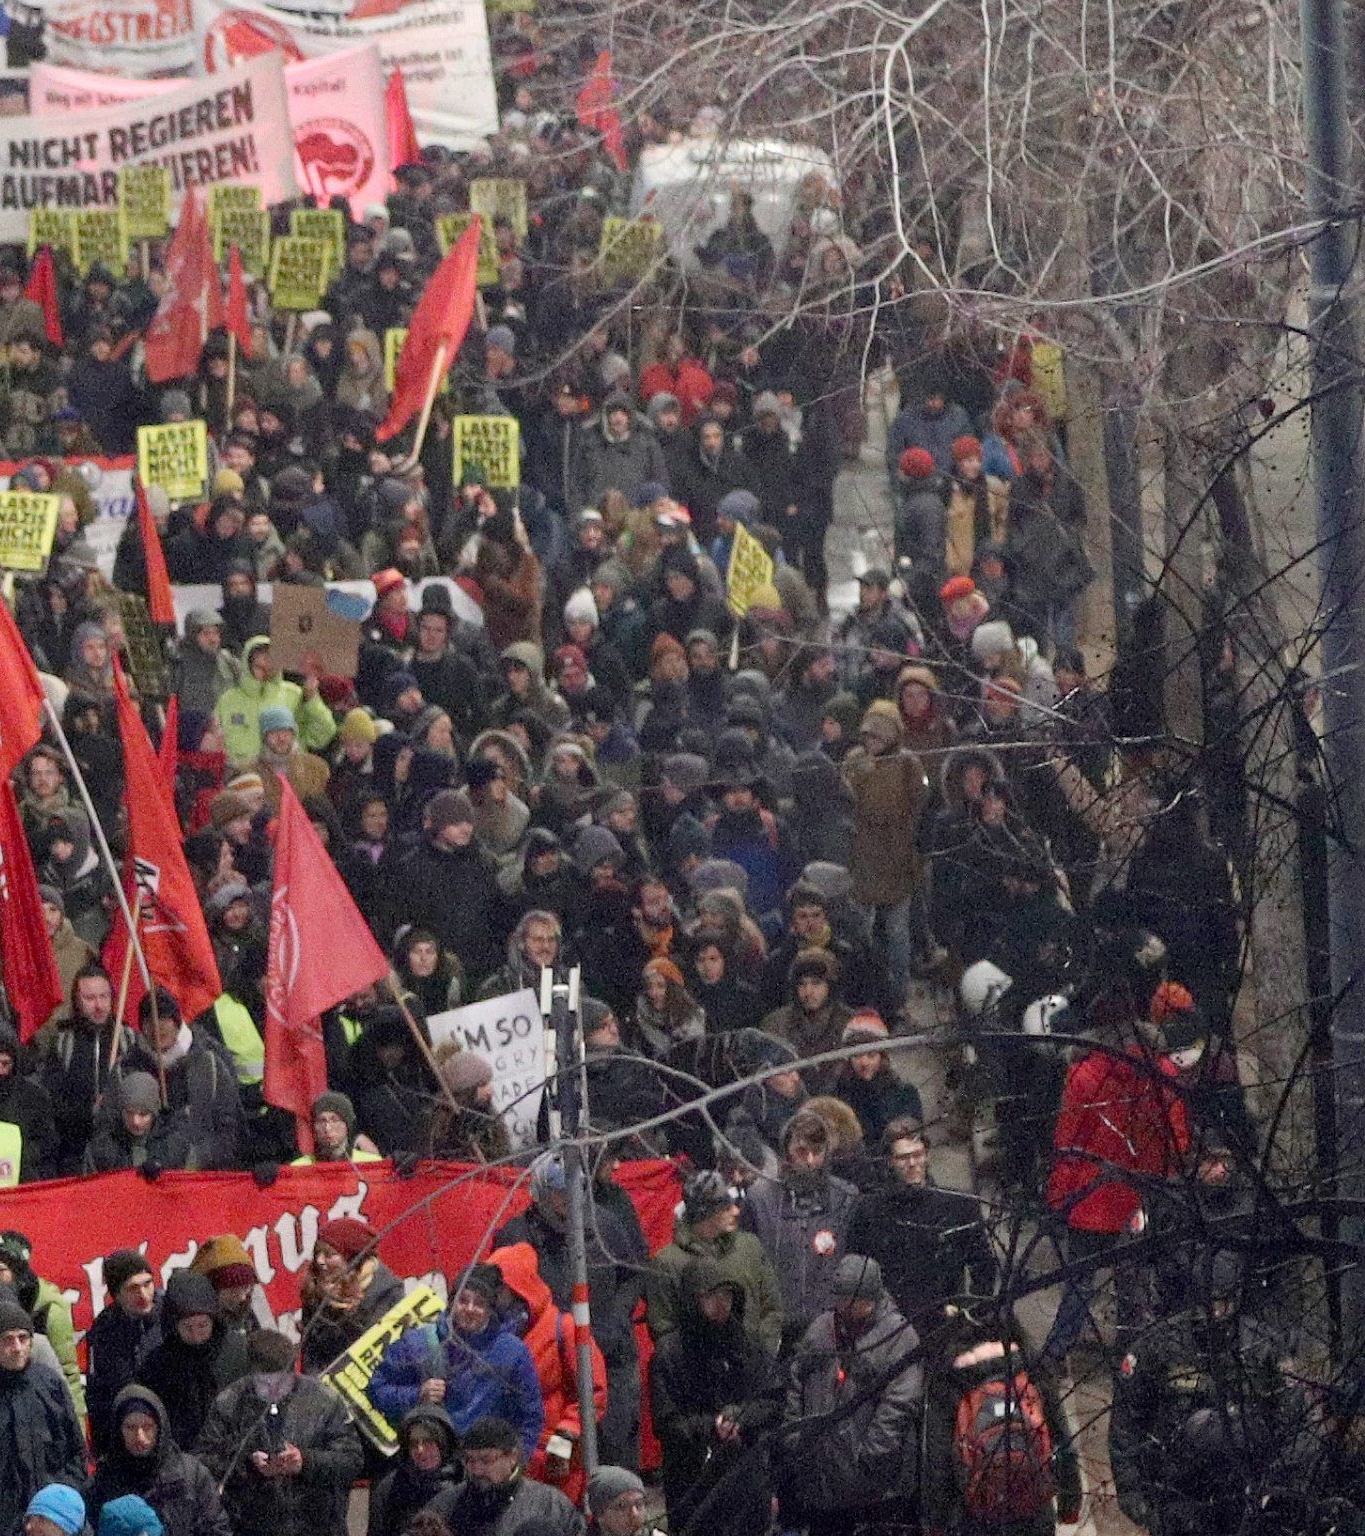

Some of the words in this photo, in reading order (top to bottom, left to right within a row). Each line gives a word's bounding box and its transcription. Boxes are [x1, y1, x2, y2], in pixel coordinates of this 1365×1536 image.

[9, 134, 99, 170] NICHT
[107, 79, 256, 163] REGIEREN
[145, 425, 198, 443] LASST
[460, 421, 510, 436] LASST
[147, 440, 200, 458] NAZIS
[462, 438, 510, 454] NAZIS
[148, 456, 200, 474] NICHT
[495, 1015, 532, 1047] SO
